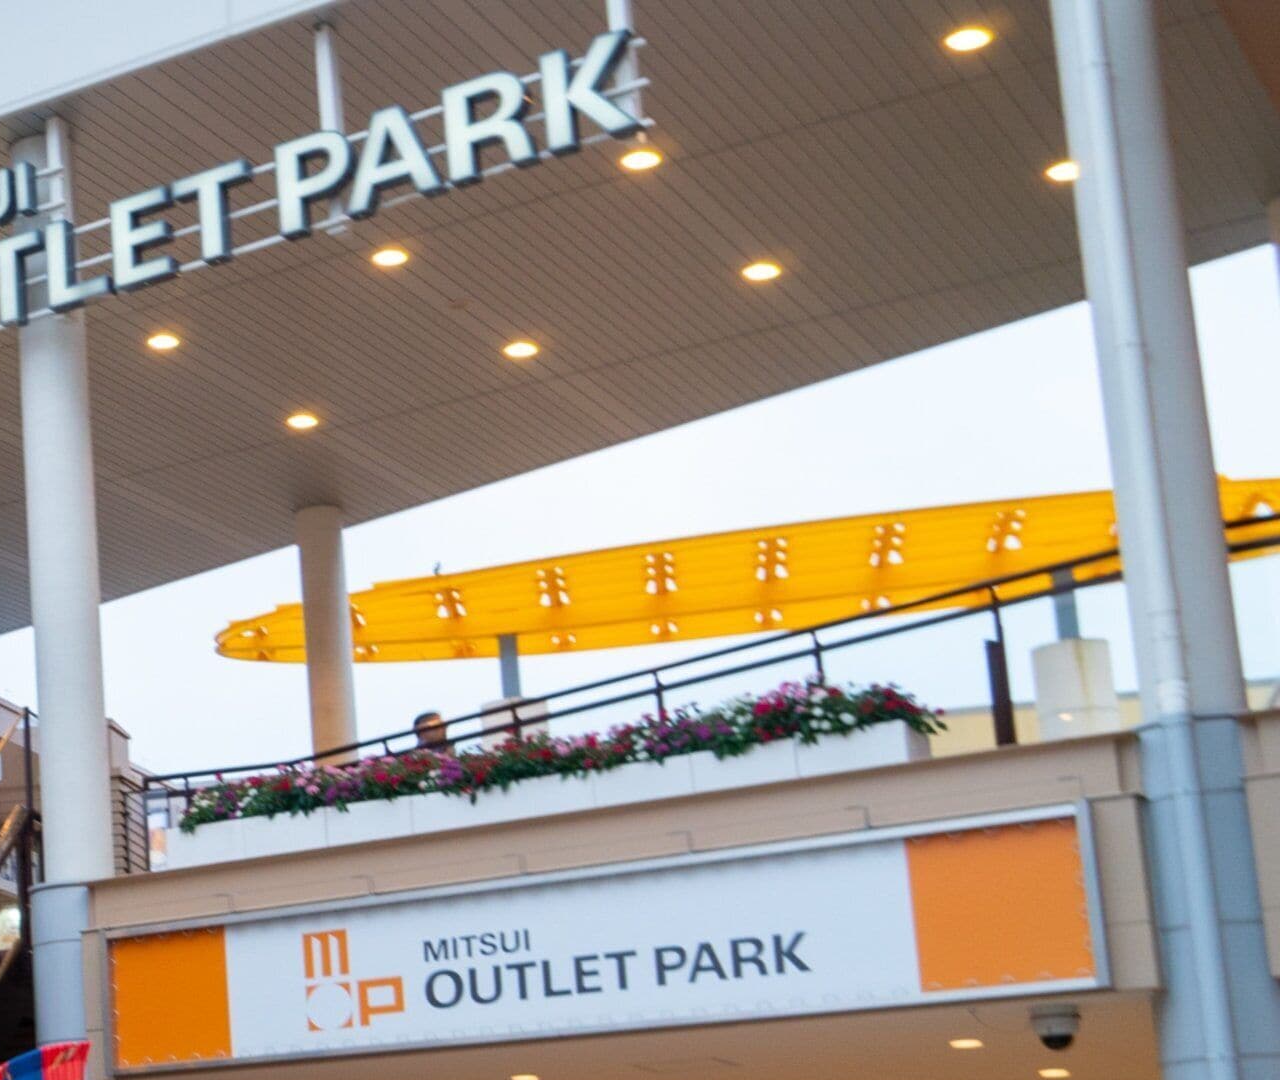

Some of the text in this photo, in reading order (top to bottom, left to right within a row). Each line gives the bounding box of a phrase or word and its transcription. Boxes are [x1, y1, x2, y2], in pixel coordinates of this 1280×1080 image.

[273, 29, 644, 241] PARK
[423, 928, 532, 964] MITSUI
[424, 930, 813, 1010] OUTLET PARK
